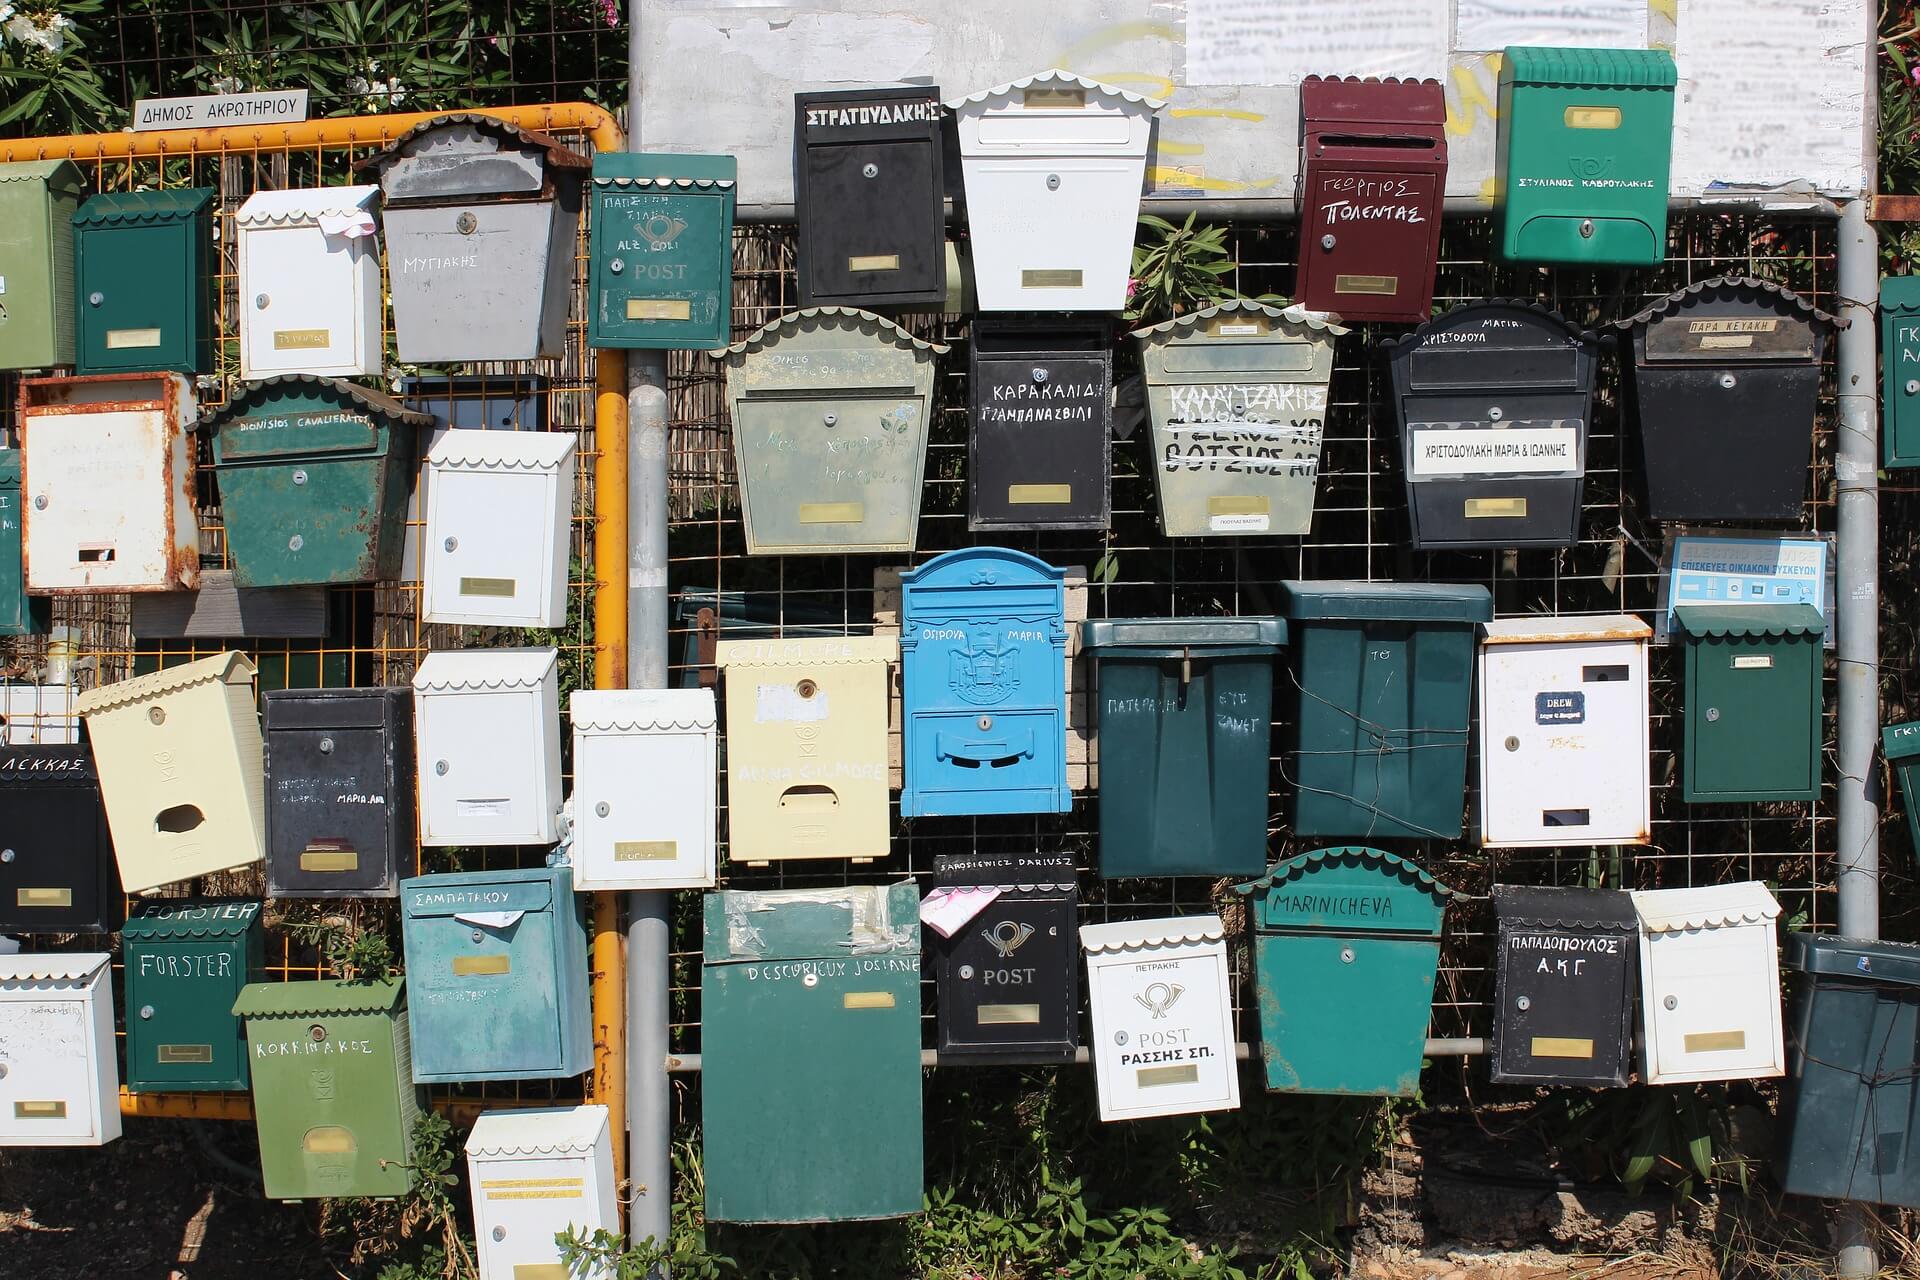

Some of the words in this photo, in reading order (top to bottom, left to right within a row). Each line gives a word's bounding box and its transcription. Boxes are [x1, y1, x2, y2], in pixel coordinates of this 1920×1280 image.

[143, 106, 194, 123] ΔΗΜΟΣ
[208, 99, 297, 119] ΑΚΡΩΤΗΡΙΟΥ
[806, 101, 940, 126] ΣΤΡΑΤΟΥΔΑΚΗΣ
[1324, 178, 1420, 197] ΓΕΩΡΓΙΟΣ
[1321, 200, 1425, 224] ΠΟΛΕΝΤΑΣ
[634, 263, 687, 280] POST
[1691, 322, 1718, 332] ΠΑΡΑ
[1494, 444, 1520, 457] ΜΑΡΙΑ
[1522, 444, 1528, 456] &
[1530, 443, 1567, 457] ΙΩΑΝΝΗΣ
[1681, 561, 1727, 571] ΕΠΙΣΚΕΥΕΣ
[1729, 564, 1770, 573] ΟΙΚΙΑΚΩΝ
[1772, 565, 1816, 575] ΣΥΣΚΕΥΩΝ
[1547, 699, 1573, 708] DREW
[1019, 858, 1073, 867] DARIUSZ
[141, 902, 259, 920] FORSTER
[1273, 895, 1393, 917] MARINICHEVA
[1512, 936, 1618, 954] ΠΑΠΑΔΟΠΟΥΛΟΣ
[141, 953, 231, 977] FORSTER
[855, 958, 920, 976] JOSIANE
[1135, 962, 1180, 973] ΠΕΤΡΑΚΗΣ
[984, 968, 1036, 986] POST
[1140, 1028, 1190, 1048] POST
[1121, 1049, 1183, 1066] ΡΑΣΣΗΣ
[1188, 1046, 1214, 1059] ΣΠ.
